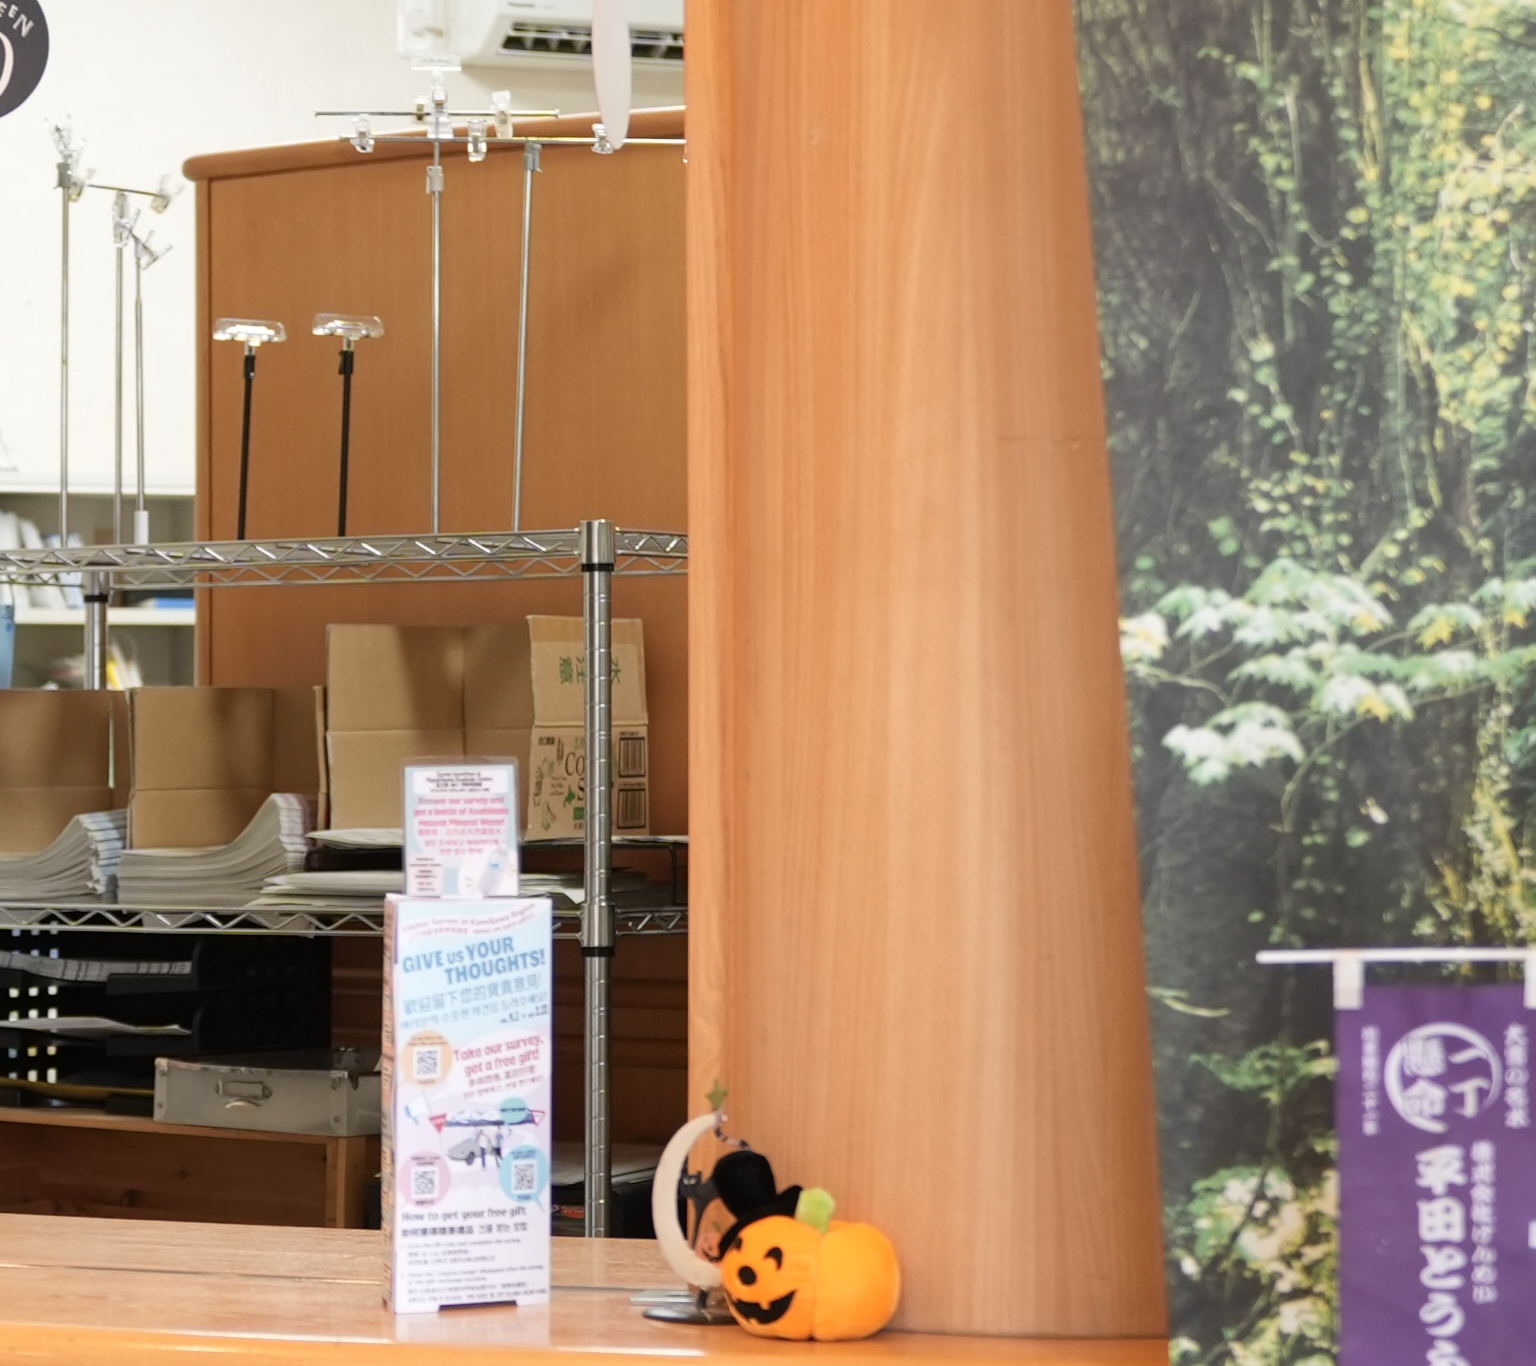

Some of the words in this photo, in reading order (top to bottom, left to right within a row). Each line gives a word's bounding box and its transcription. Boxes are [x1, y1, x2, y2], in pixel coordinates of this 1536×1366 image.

[402, 950, 444, 974] GIVE
[466, 936, 515, 962] YOUR
[444, 948, 546, 985] THOUGHTS!
[484, 1042, 502, 1056] our
